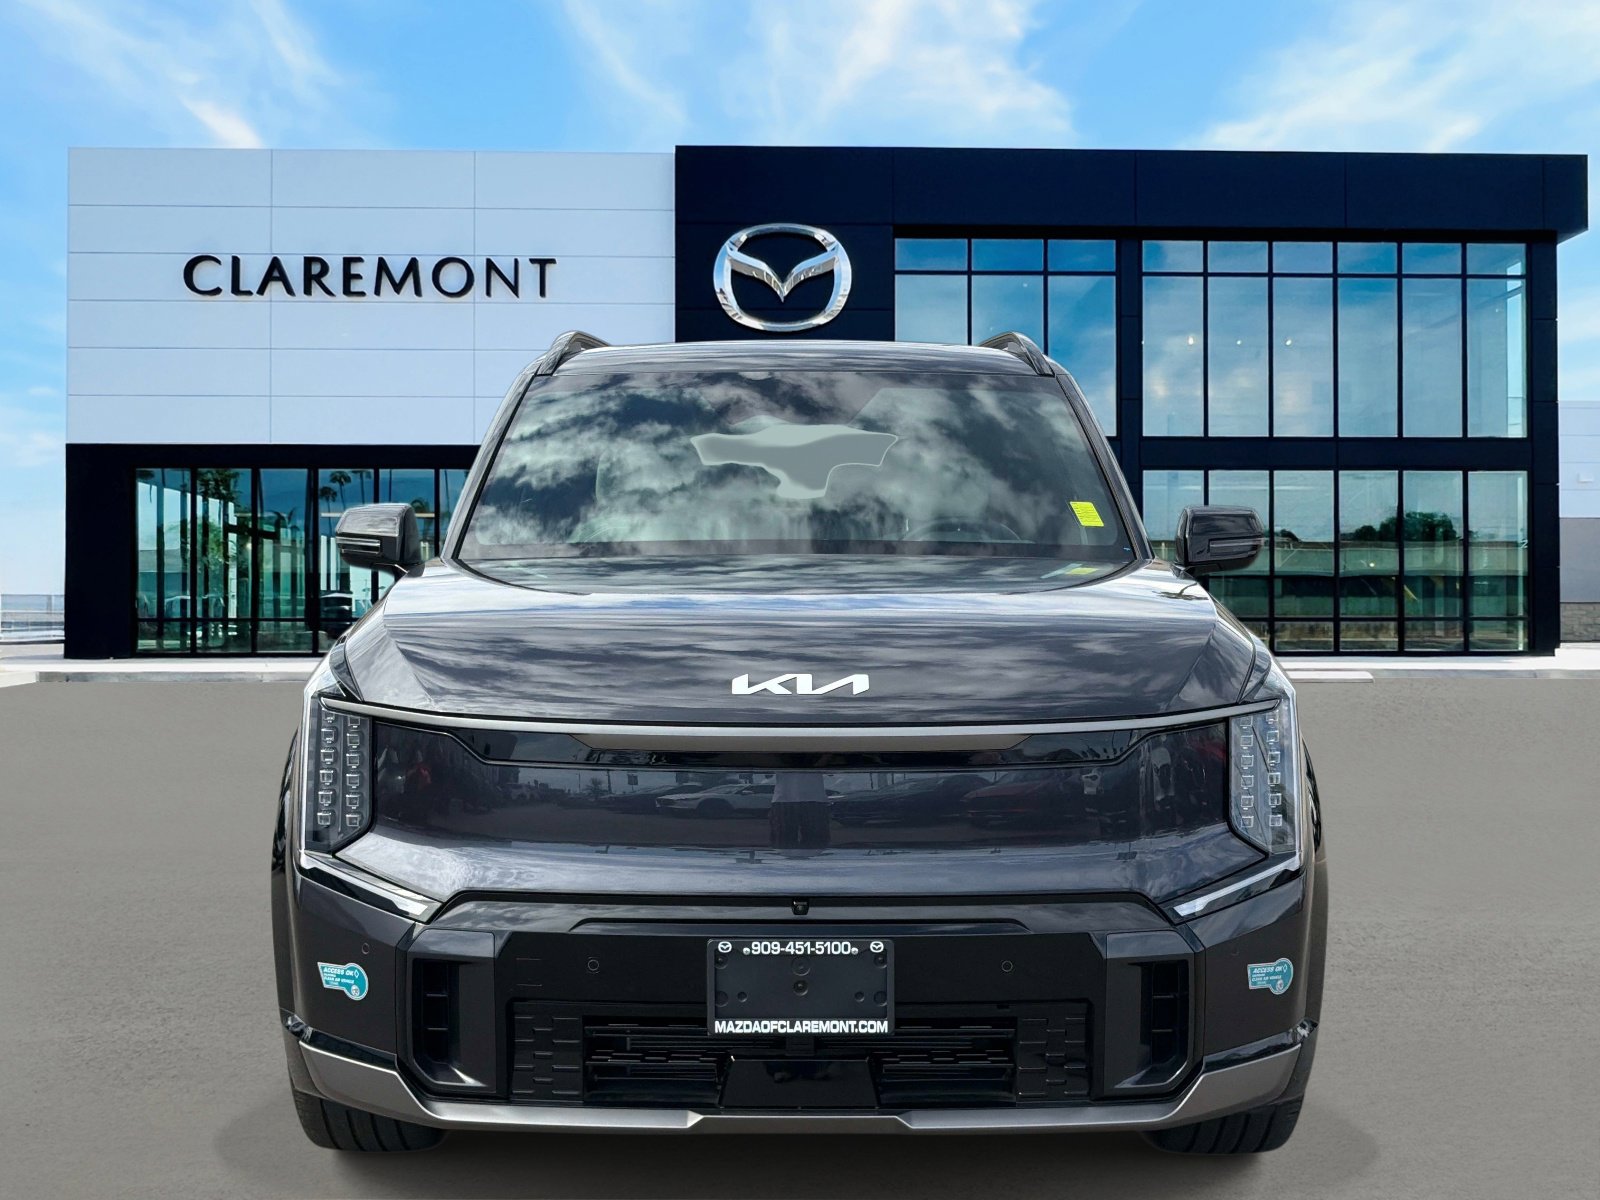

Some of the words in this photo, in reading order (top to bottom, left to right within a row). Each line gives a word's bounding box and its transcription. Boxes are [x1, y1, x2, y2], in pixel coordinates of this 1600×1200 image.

[183, 254, 557, 298] CLAREMONT
[732, 673, 869, 696] KIA
[751, 941, 851, 955] 909-451-5100
[323, 966, 345, 975] ACCESS
[1252, 966, 1275, 974] ACCESS
[714, 1020, 889, 1034] MAZDAOFCLAREMONT.COM
